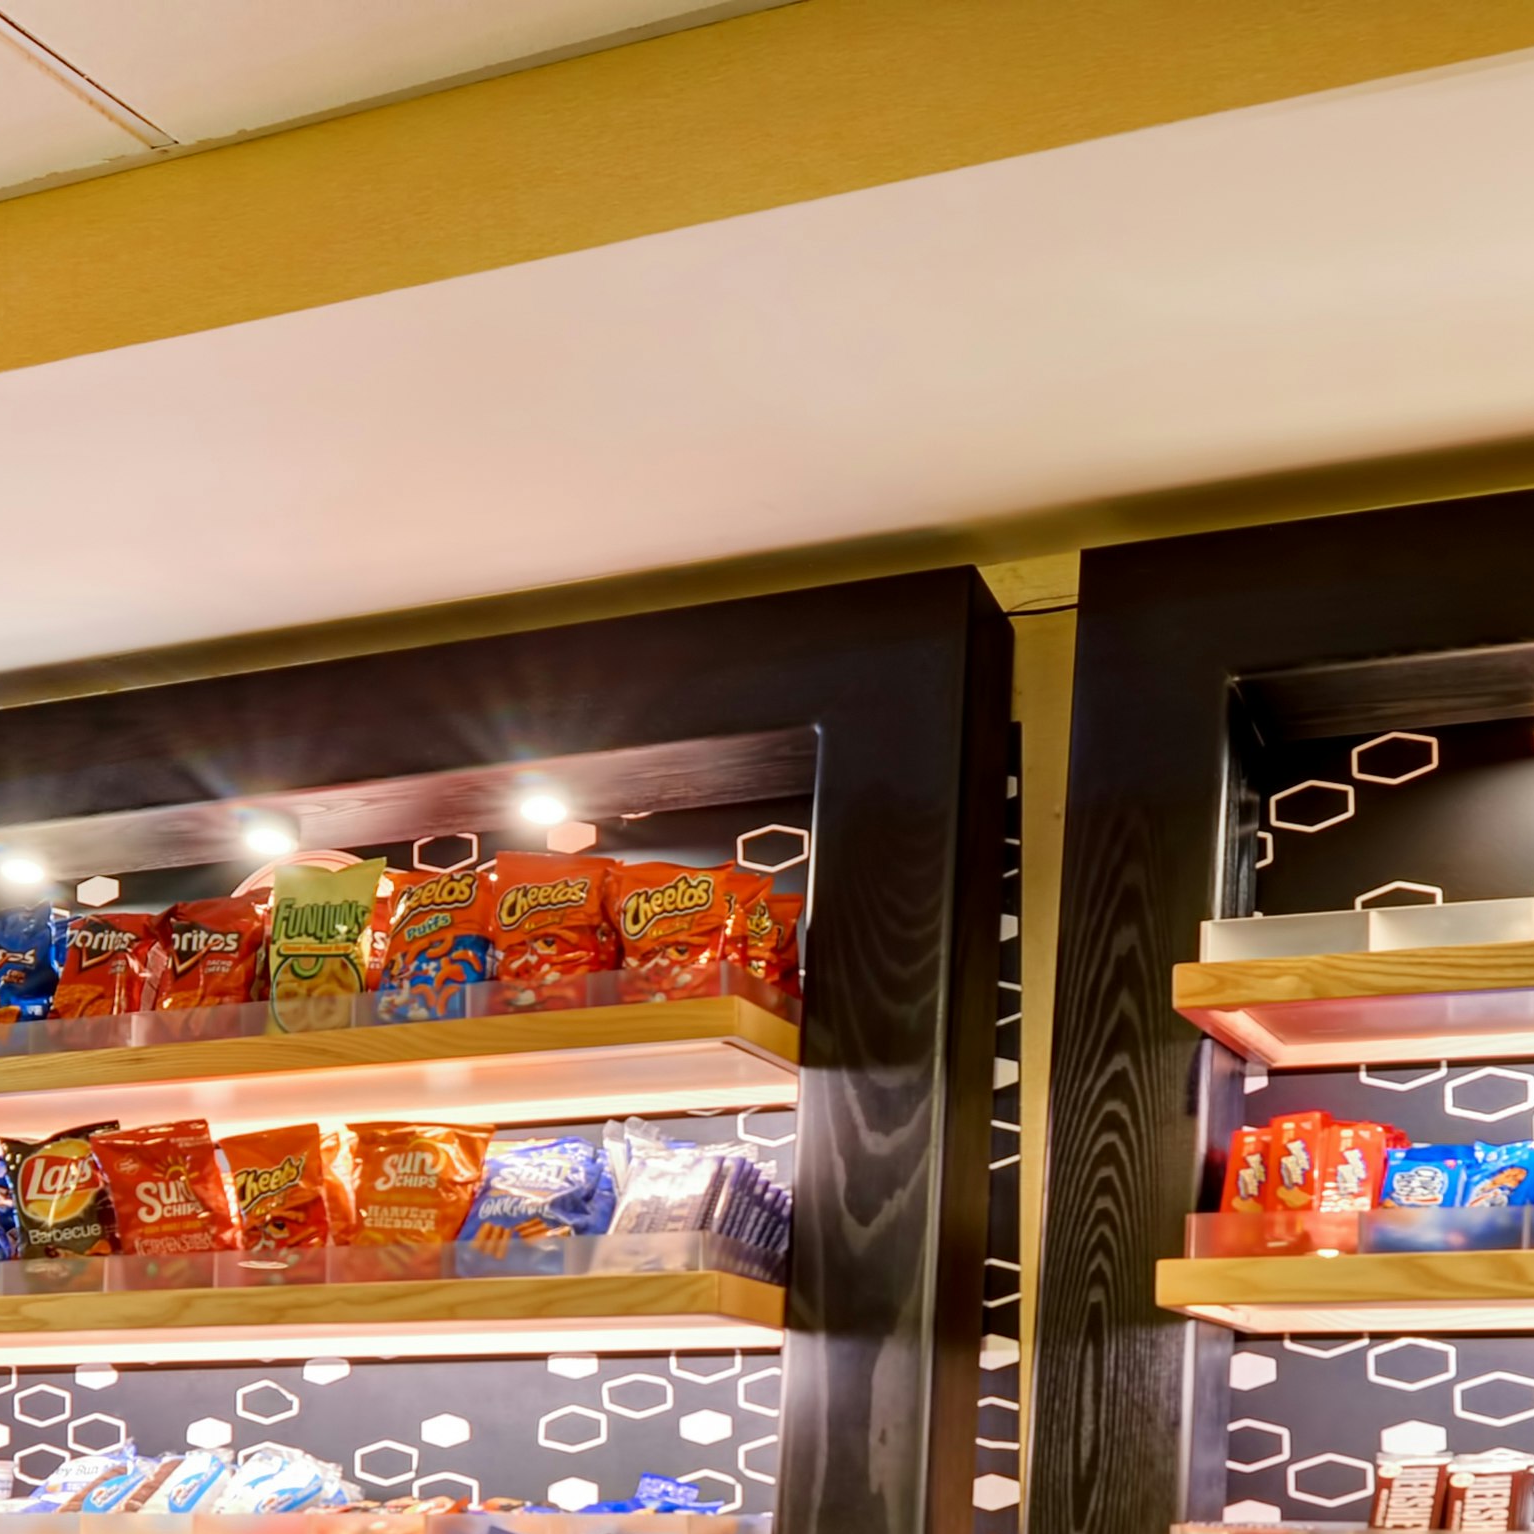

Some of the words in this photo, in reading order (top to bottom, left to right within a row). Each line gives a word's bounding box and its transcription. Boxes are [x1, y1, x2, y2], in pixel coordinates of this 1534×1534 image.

[499, 878, 589, 929] Cheetos
[623, 874, 713, 939] Cheetos
[405, 913, 452, 940] Puffs
[171, 930, 239, 951] oritos
[395, 1175, 437, 1189] CHIPS
[163, 1201, 203, 1218] CHIPS
[28, 1222, 102, 1245] Barbecue
